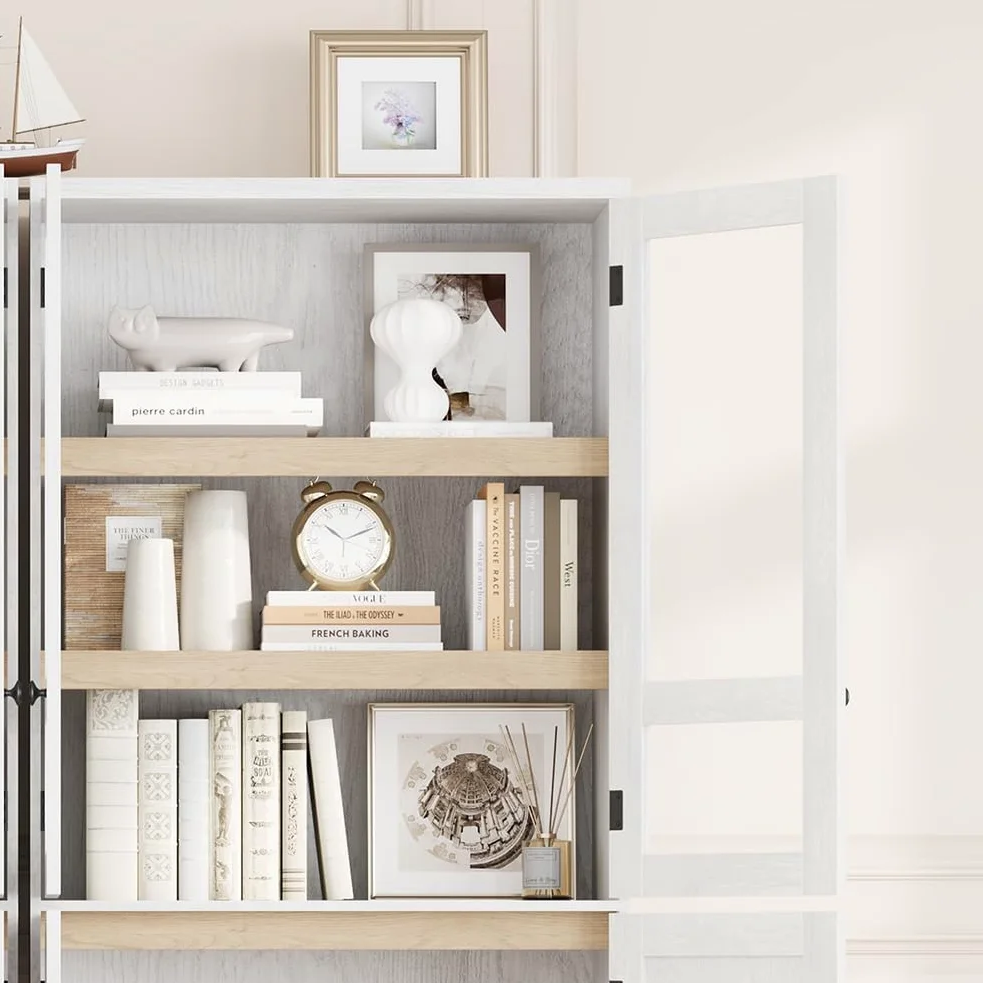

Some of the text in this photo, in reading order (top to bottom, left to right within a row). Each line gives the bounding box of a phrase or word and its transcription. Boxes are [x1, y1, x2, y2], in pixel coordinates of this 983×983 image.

[132, 407, 165, 417] pierre
[169, 406, 205, 416] cardin
[477, 541, 485, 573] design
[524, 539, 540, 571] Dior
[564, 561, 574, 588] West
[353, 593, 386, 603] VOGUE
[323, 610, 395, 619] THE ILIAD THE ODYSSEY
[311, 629, 390, 638] FRENCH BAKING
